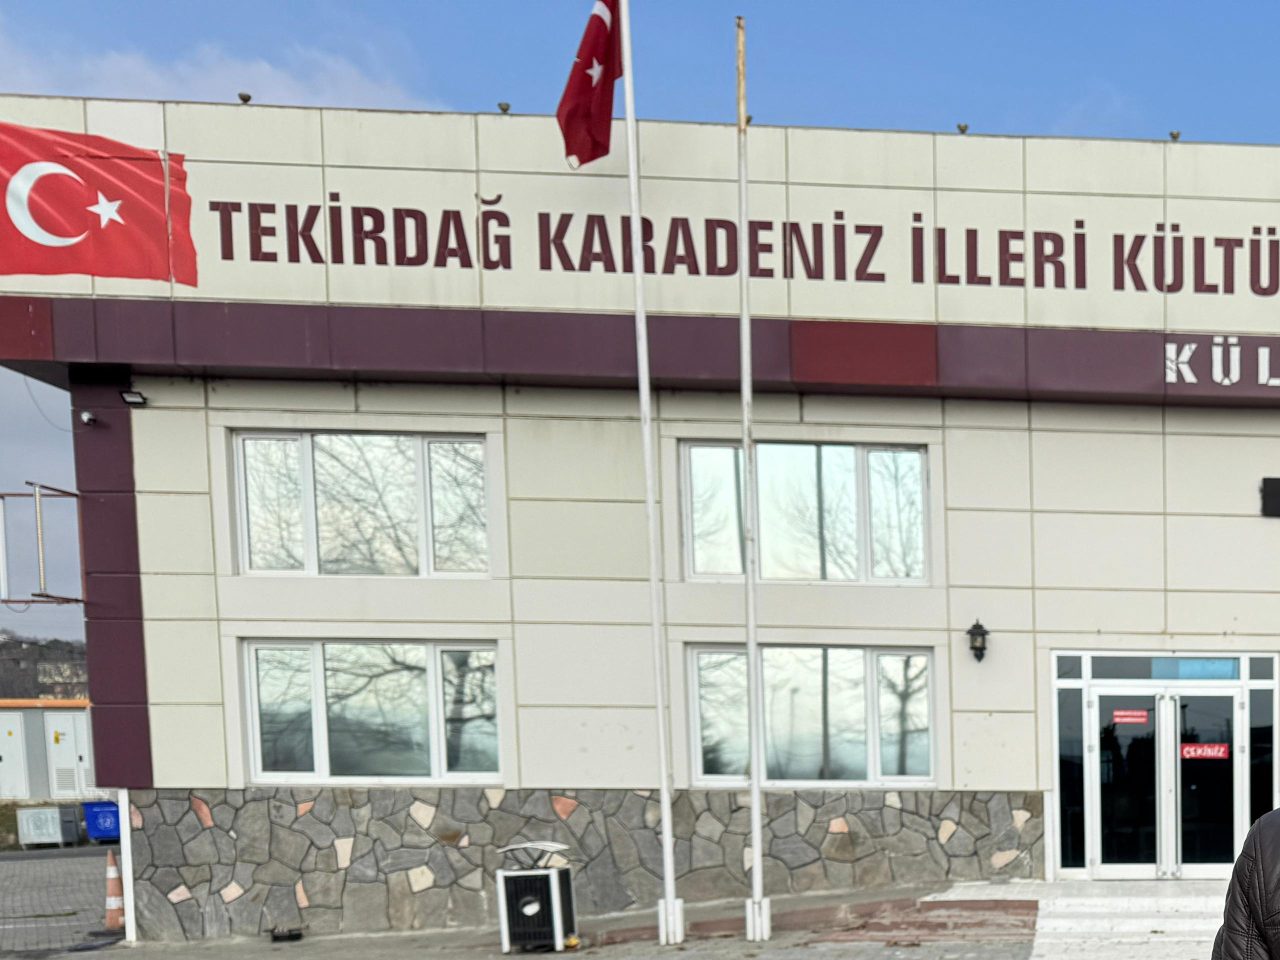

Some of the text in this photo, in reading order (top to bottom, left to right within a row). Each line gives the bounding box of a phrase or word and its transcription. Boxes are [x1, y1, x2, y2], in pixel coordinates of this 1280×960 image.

[209, 191, 513, 270] TEKİRDAĞ
[538, 210, 887, 283] KARADENİZ
[911, 212, 1088, 290] İLLERİ
